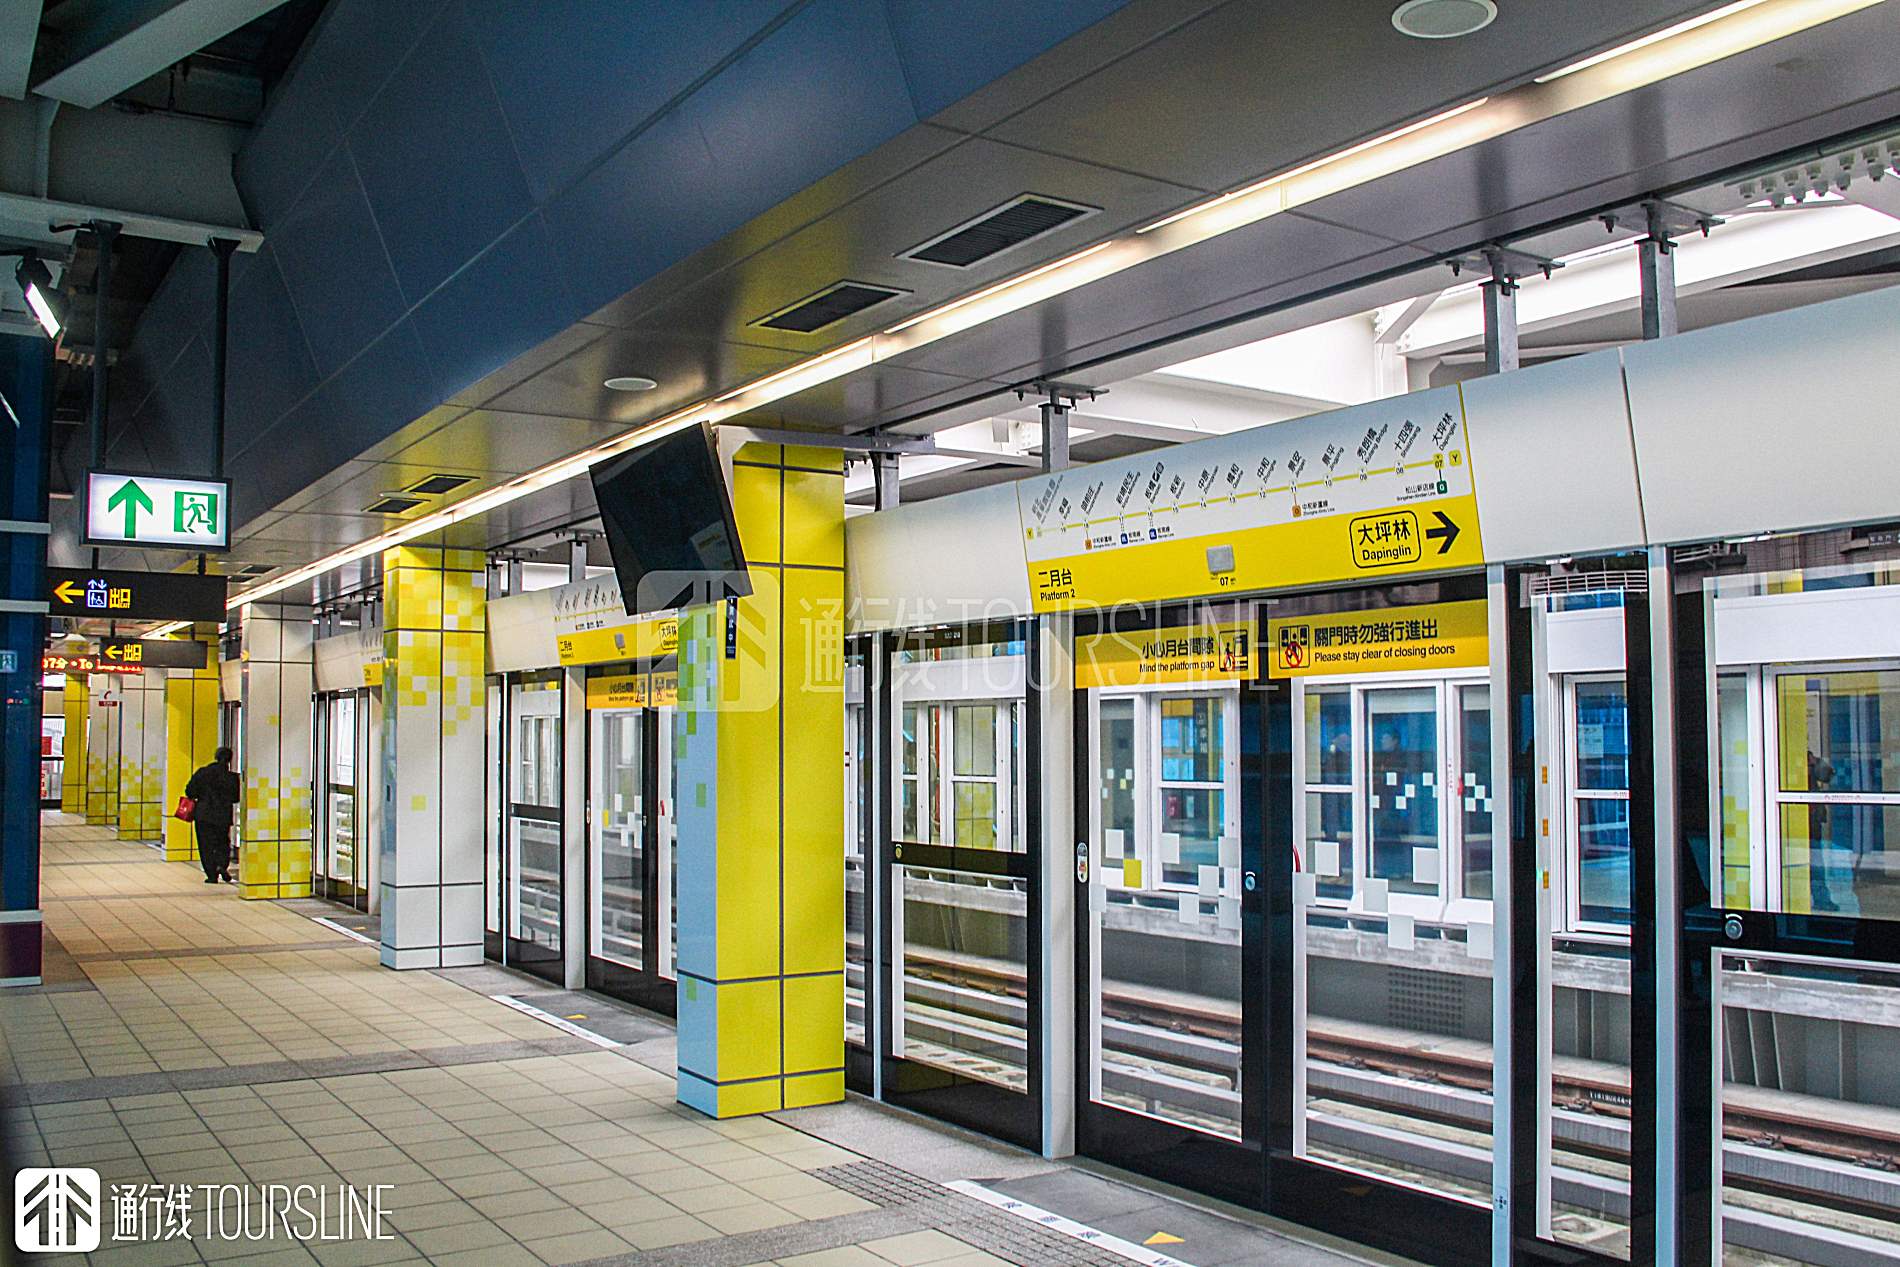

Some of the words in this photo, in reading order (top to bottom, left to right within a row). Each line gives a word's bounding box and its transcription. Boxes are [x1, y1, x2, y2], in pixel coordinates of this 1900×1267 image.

[1358, 518, 1411, 546] 大坪林
[1362, 545, 1412, 561] Dapinglin
[1038, 568, 1073, 588] 二月台
[1219, 577, 1229, 586] 07
[109, 588, 130, 608] 出口
[1040, 590, 1070, 601] Platform
[1070, 589, 1076, 598] 2
[1314, 618, 1438, 647] 關門時勿強行進出
[1142, 636, 1214, 659] 小心月台間隙
[1315, 651, 1342, 662] Please
[1343, 651, 1360, 662] stay
[1361, 650, 1381, 660] clear
[1384, 648, 1393, 657] of
[1394, 646, 1427, 658] closing
[1428, 644, 1456, 654] doors
[1139, 663, 1157, 673] Mind
[1157, 662, 1169, 672] the
[1170, 661, 1200, 673] platform
[1200, 660, 1215, 671] gap
